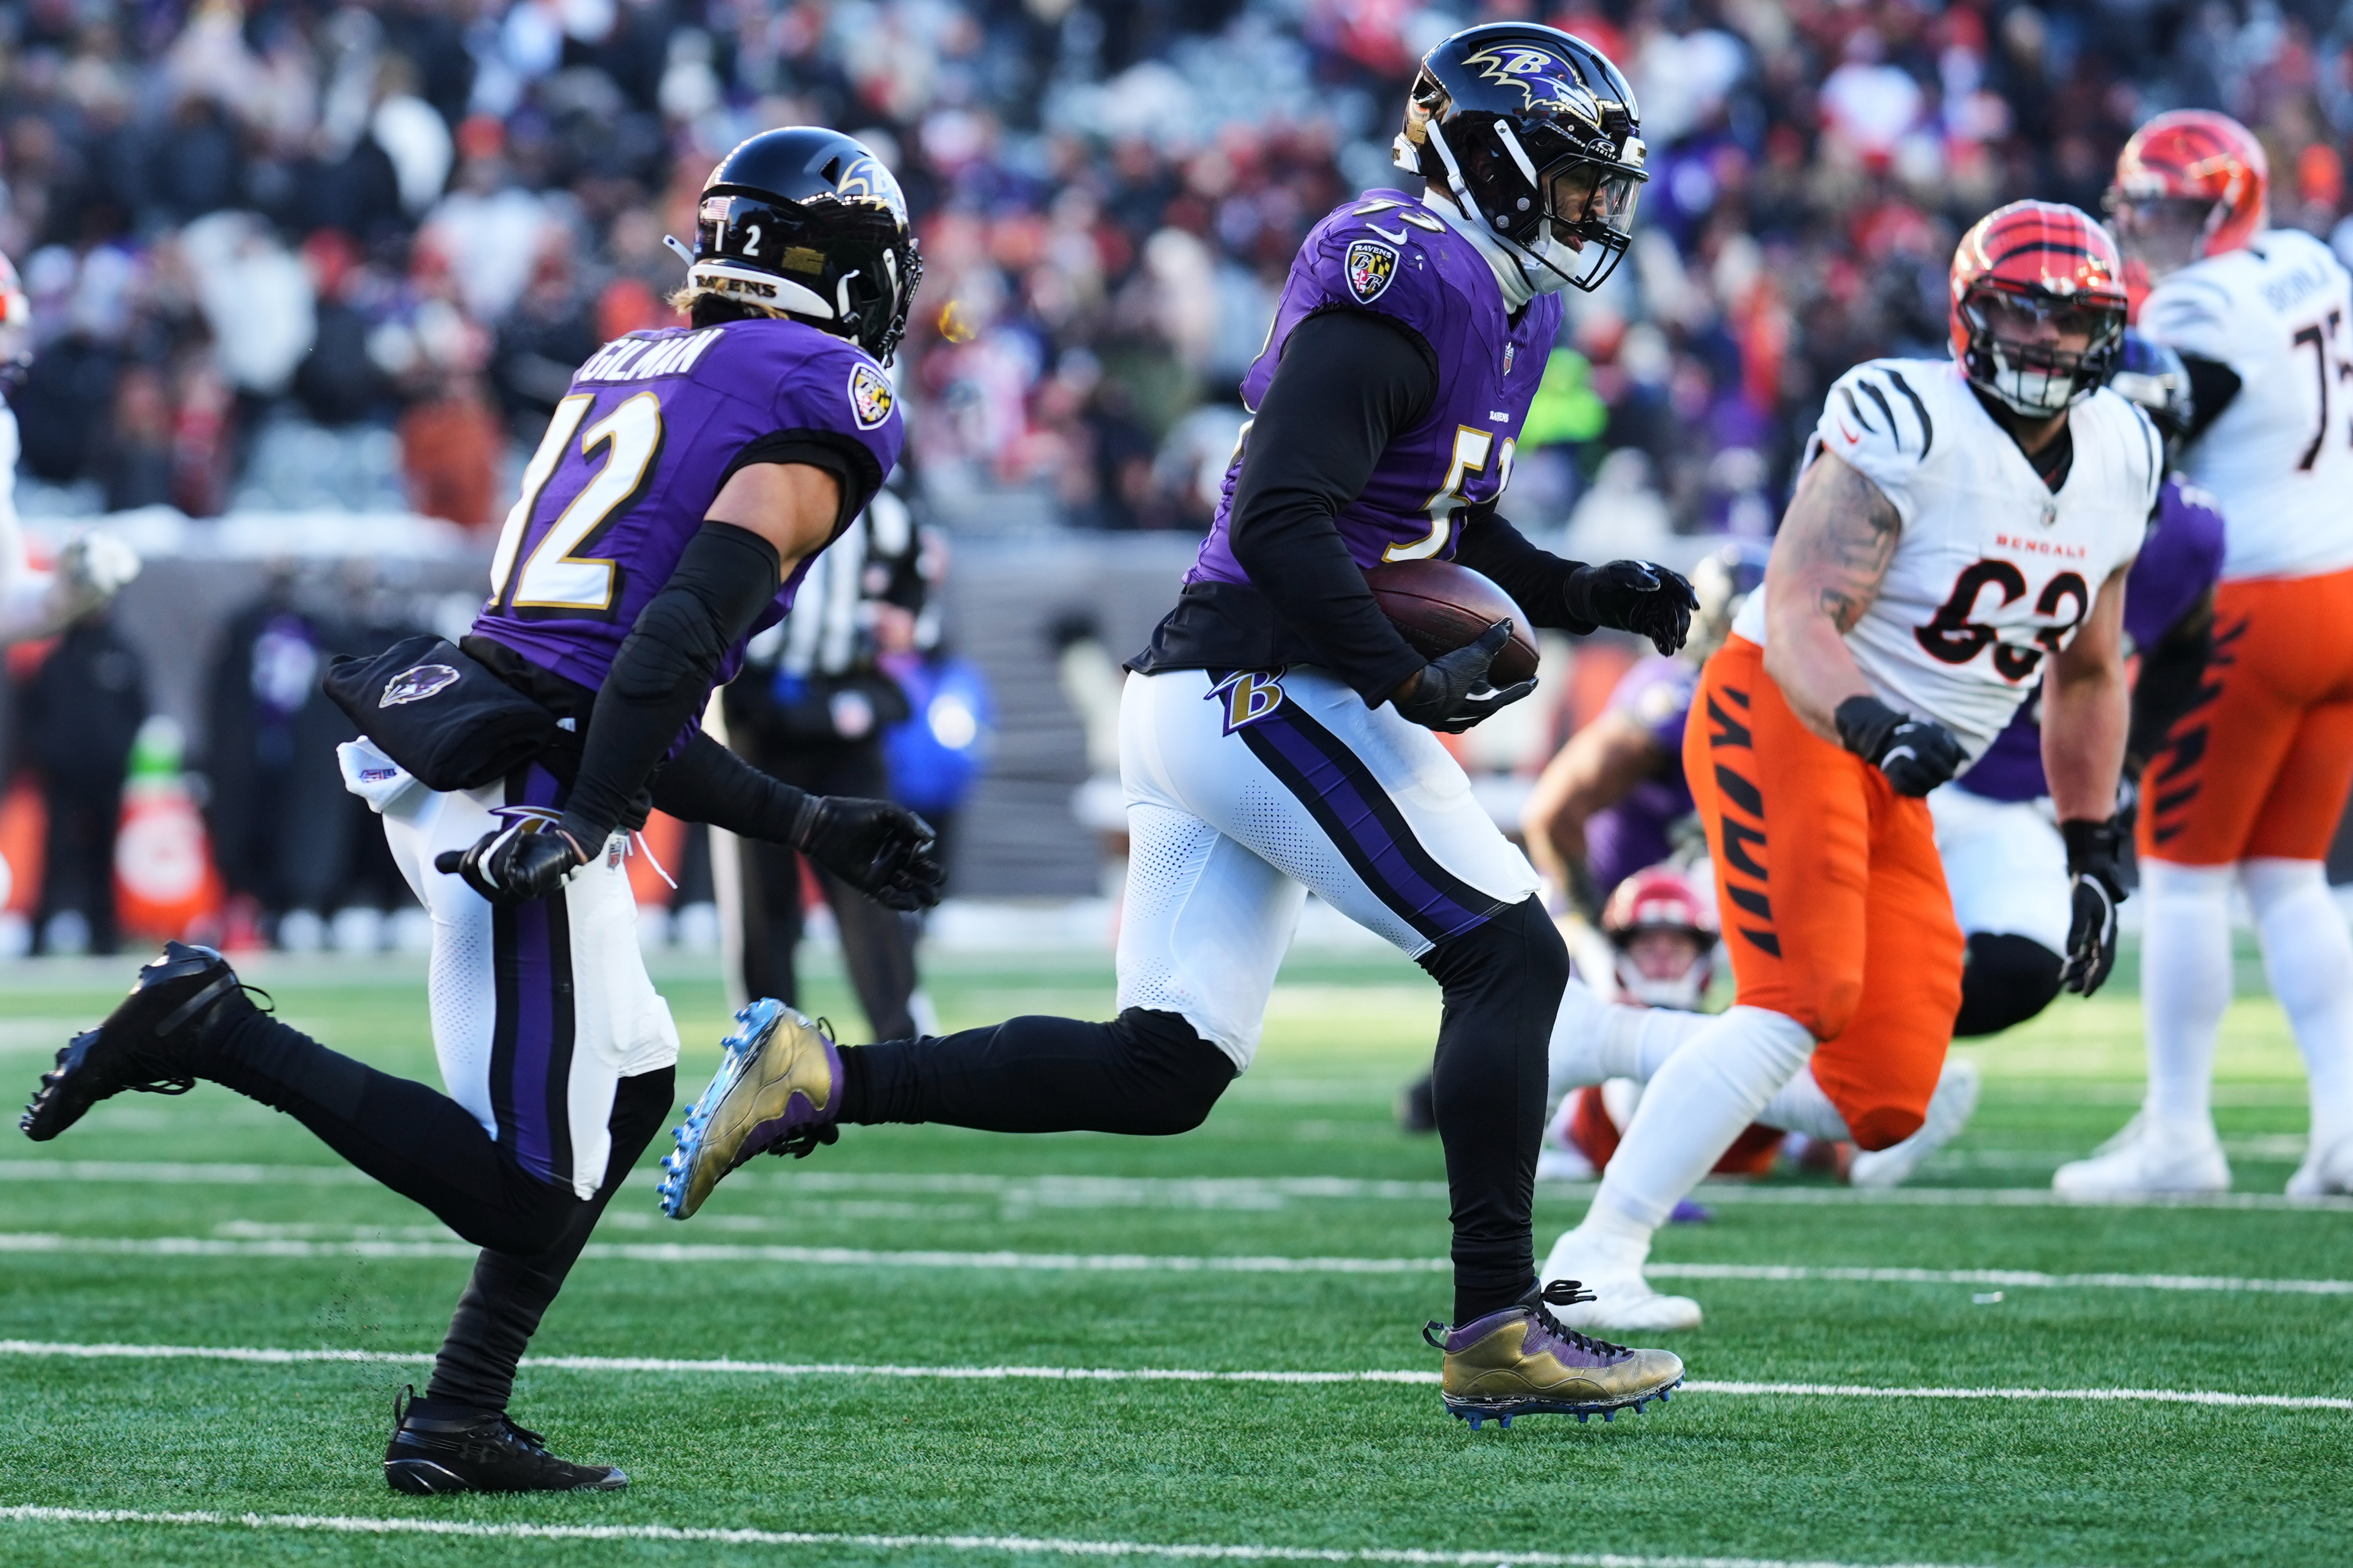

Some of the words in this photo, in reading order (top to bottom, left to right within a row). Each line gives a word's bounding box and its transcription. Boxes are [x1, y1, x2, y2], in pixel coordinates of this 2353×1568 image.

[1590, 145, 1616, 160] OAKLEY
[714, 221, 762, 257] 12
[1354, 245, 1392, 258] RAVENS
[579, 328, 725, 381] GILMAN
[1489, 411, 1509, 423] RAVENS
[488, 391, 662, 610] 12
[1914, 558, 2089, 683] 63
